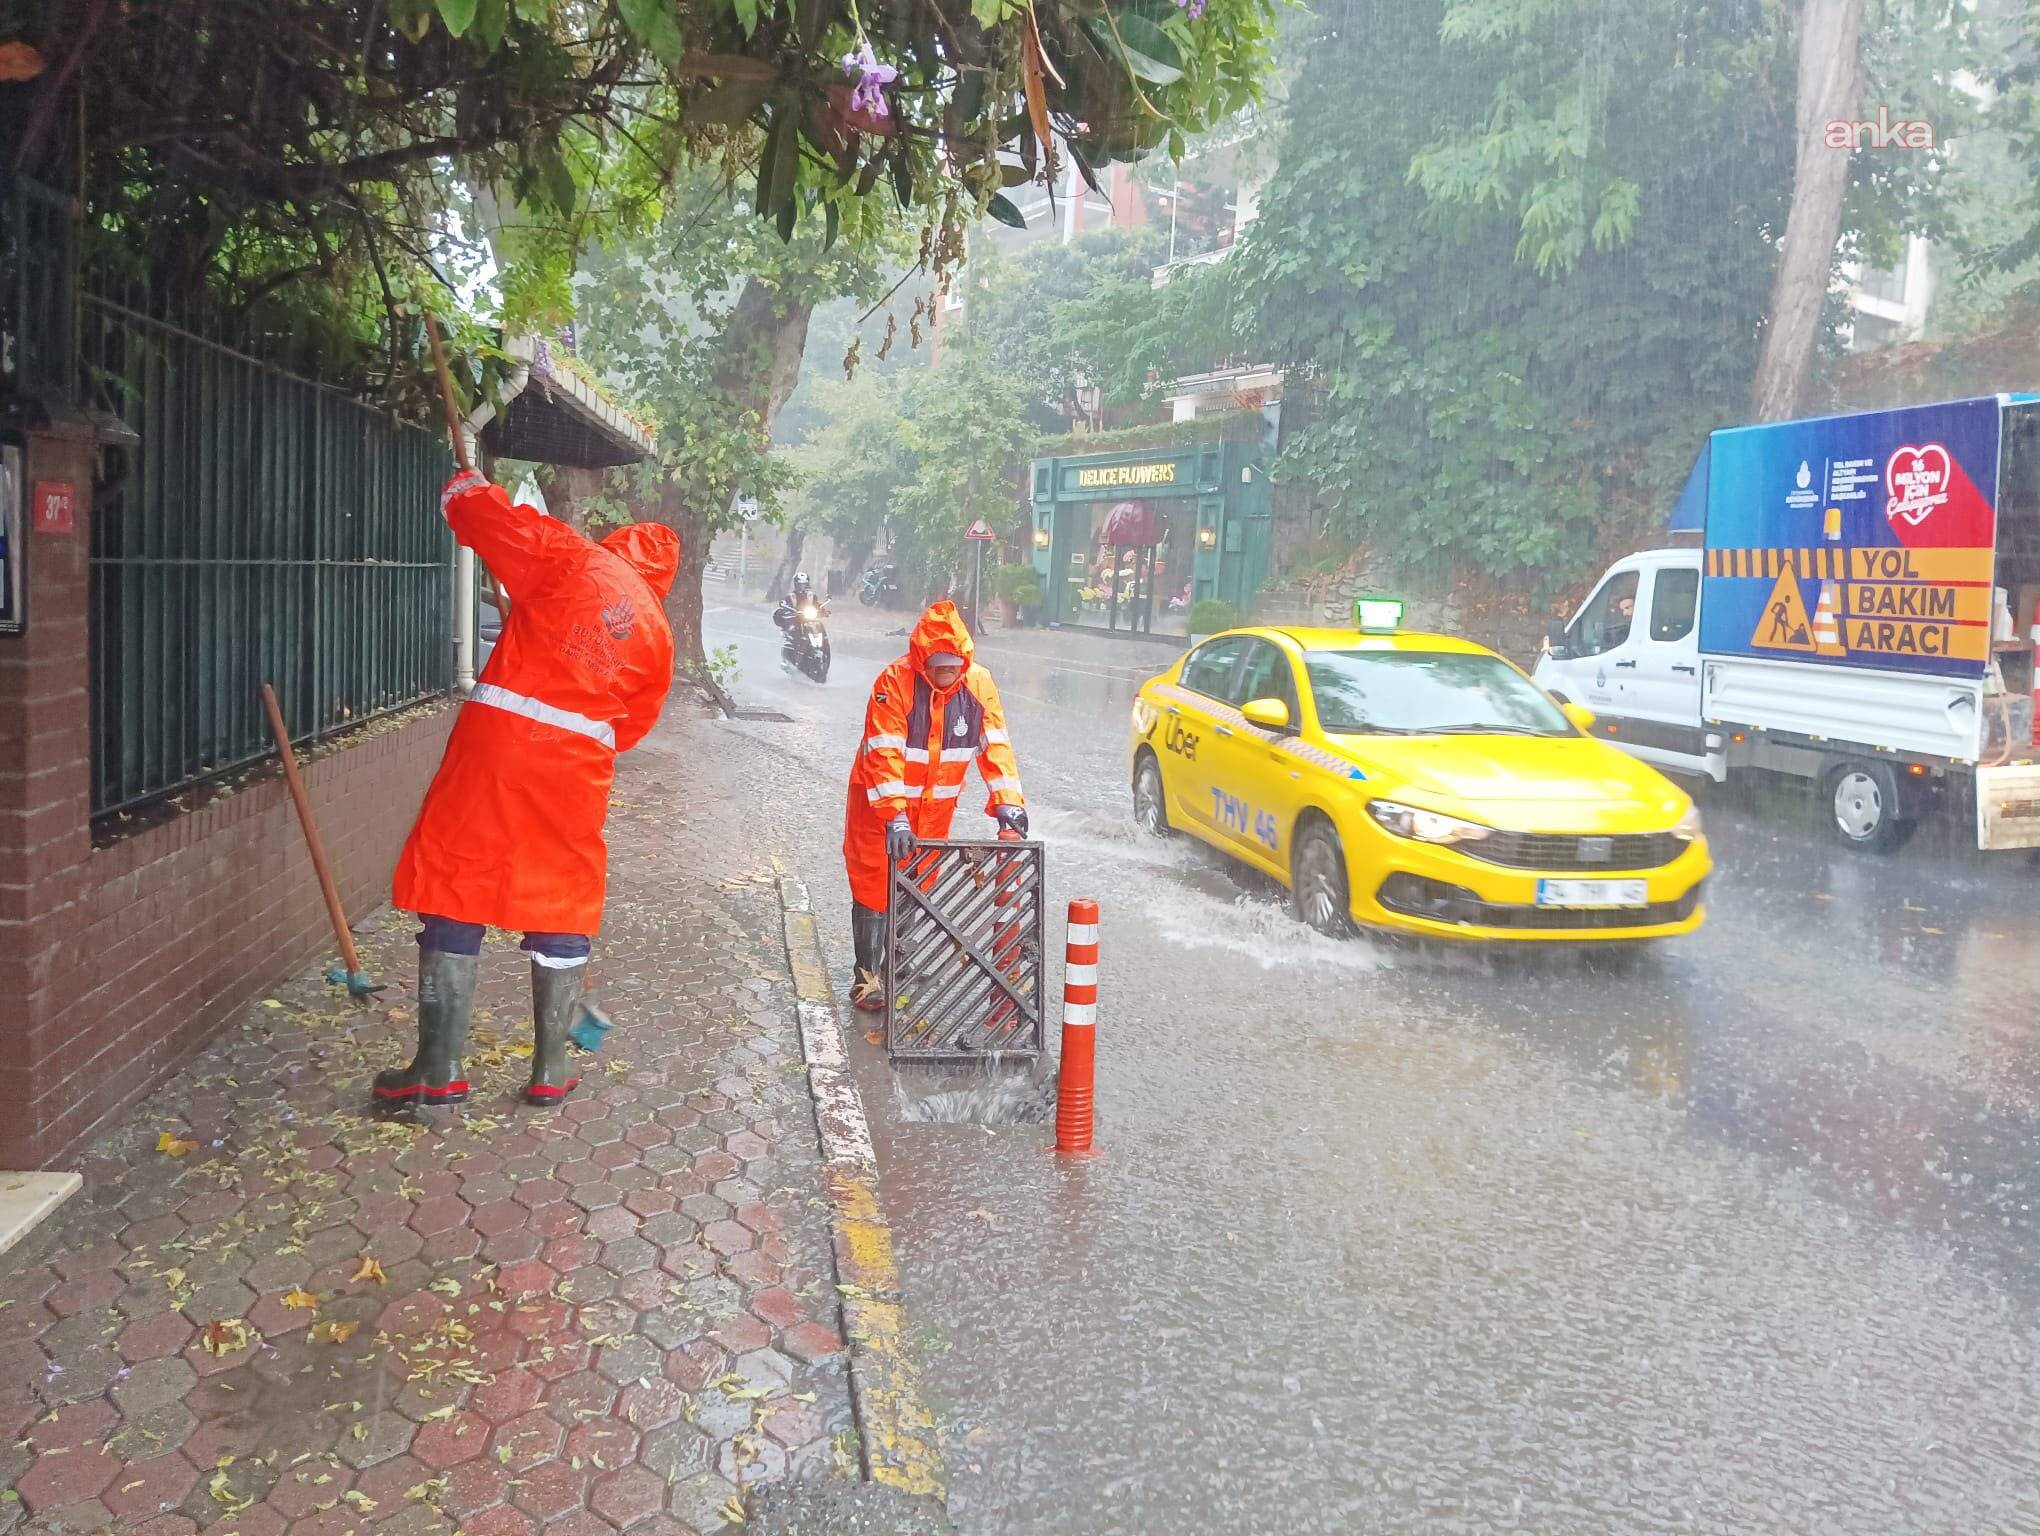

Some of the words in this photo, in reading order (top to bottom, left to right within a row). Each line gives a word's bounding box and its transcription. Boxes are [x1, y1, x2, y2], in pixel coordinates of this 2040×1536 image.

[1118, 463, 1175, 485] FLOWERS
[1861, 549, 1919, 578] YOL
[1858, 585, 1955, 618] BAKIM
[1856, 621, 1950, 655] ARACI
